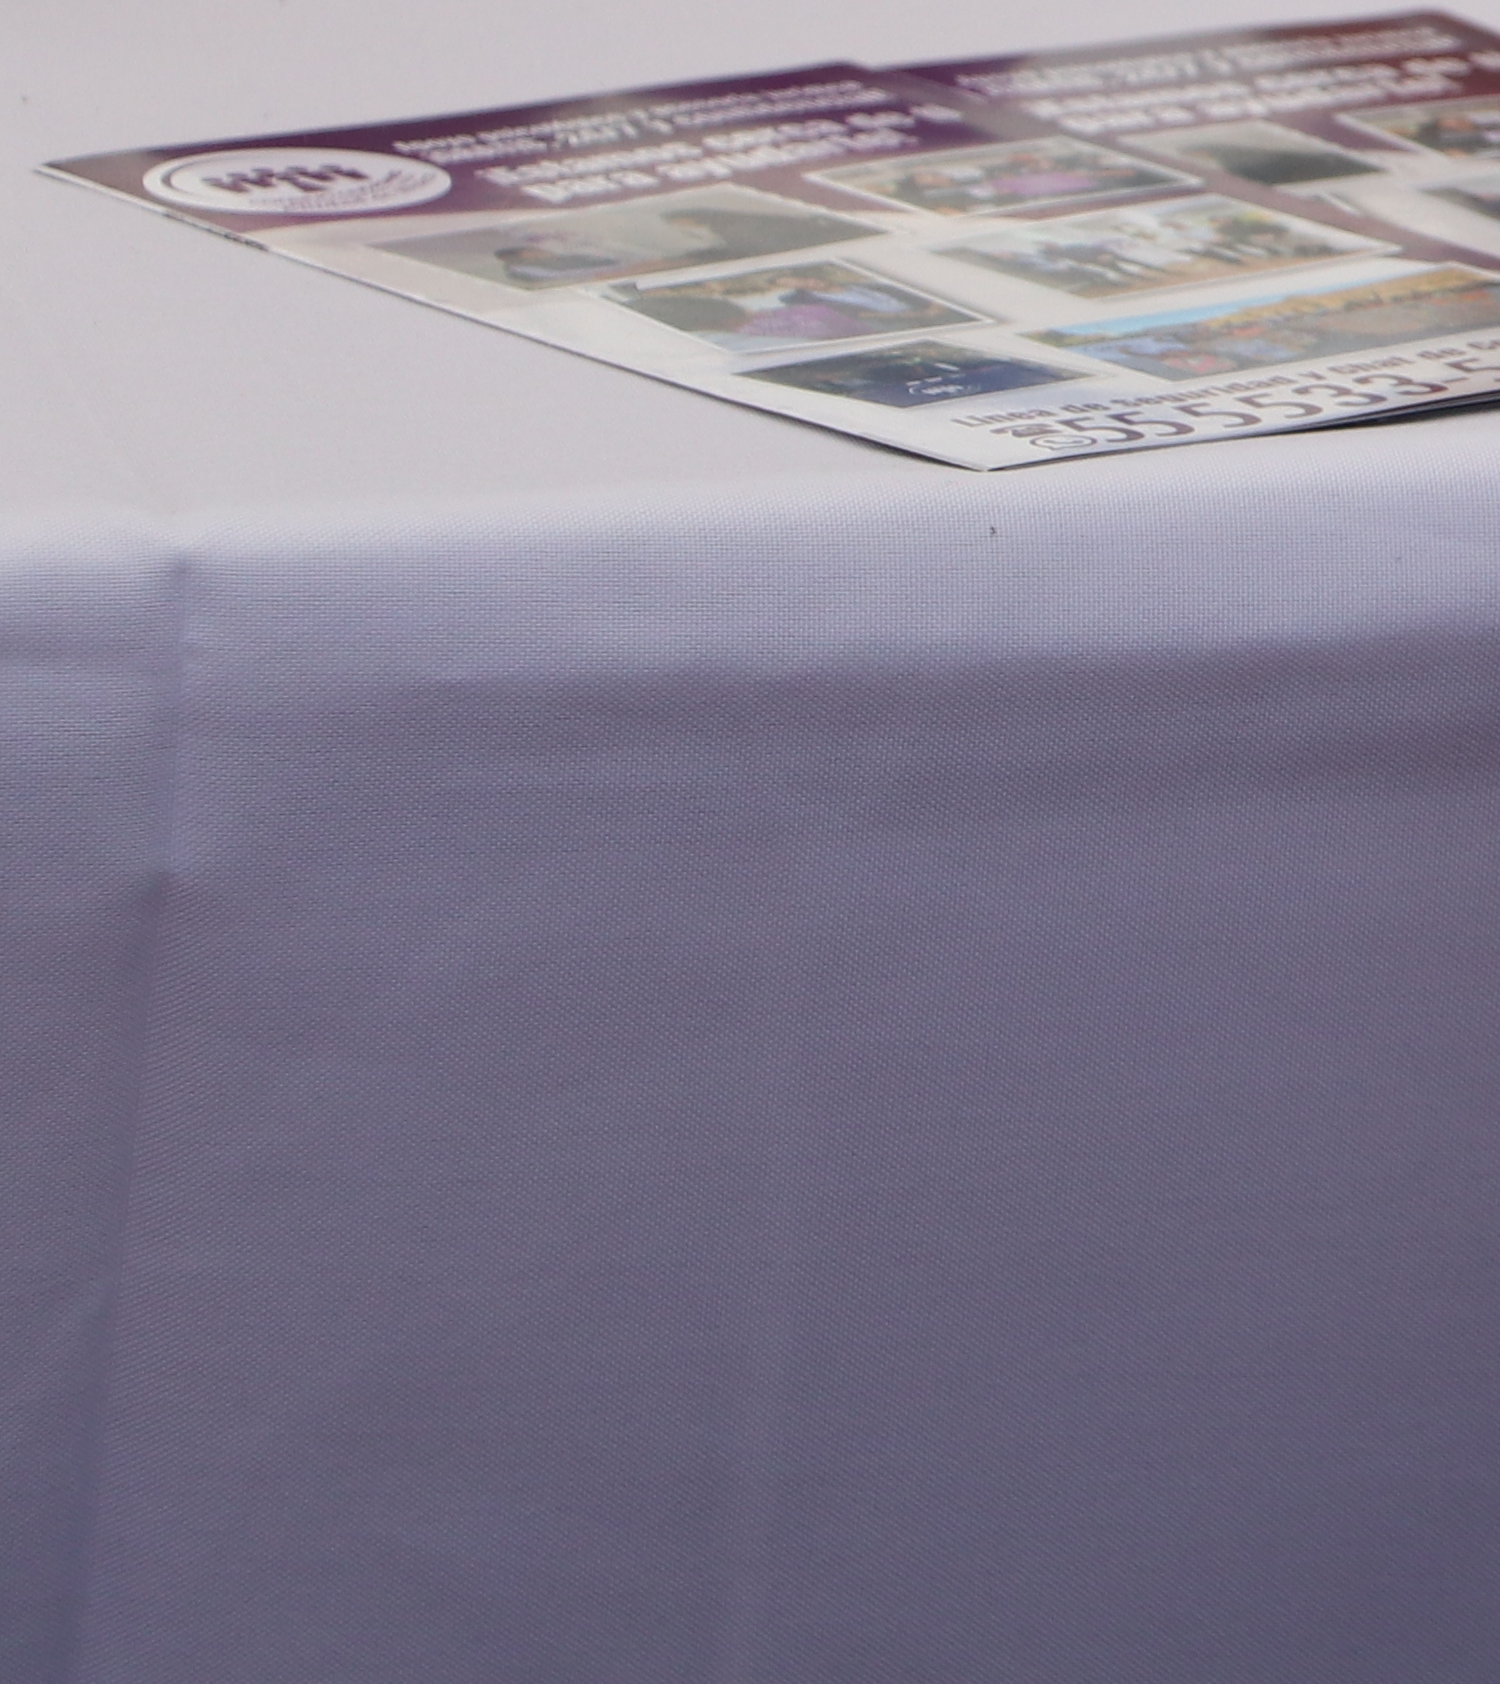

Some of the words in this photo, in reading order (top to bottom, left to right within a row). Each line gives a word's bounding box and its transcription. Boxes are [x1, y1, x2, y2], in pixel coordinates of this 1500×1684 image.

[1059, 401, 1113, 415] de
[1111, 373, 1300, 407] Seguridad
[1296, 368, 1328, 381] y
[1326, 354, 1415, 377] Chat
[1418, 345, 1468, 361] de
